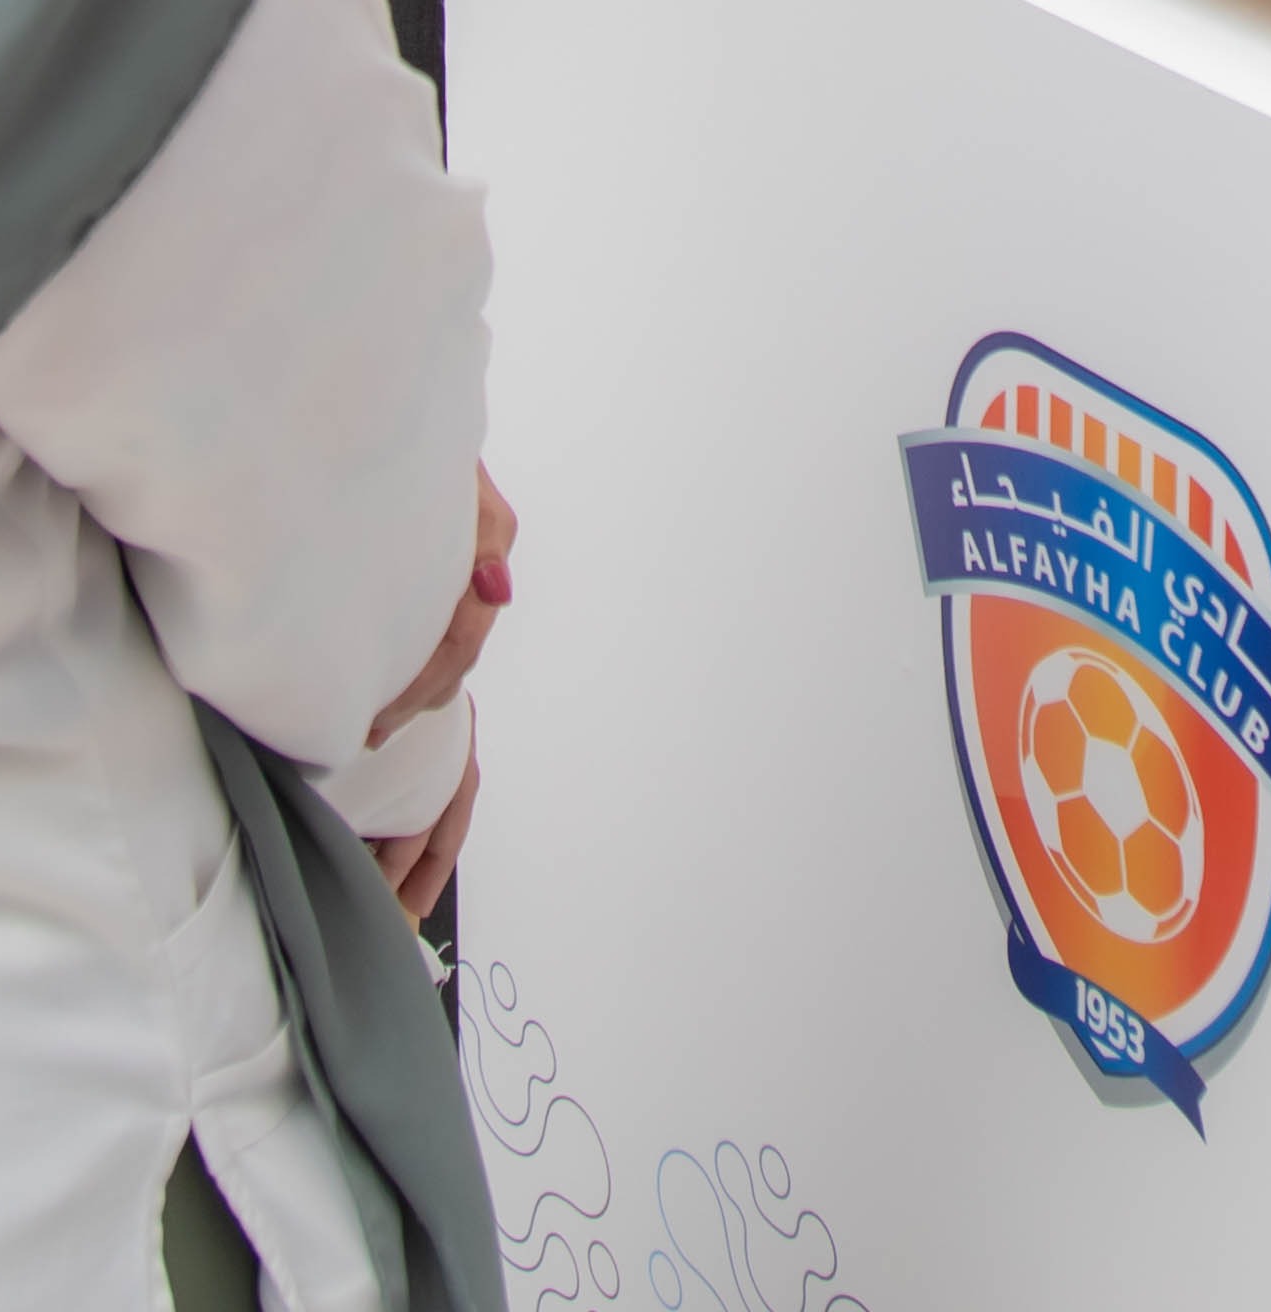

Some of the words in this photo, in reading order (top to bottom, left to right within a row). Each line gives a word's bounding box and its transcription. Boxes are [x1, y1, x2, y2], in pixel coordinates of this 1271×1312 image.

[951, 451, 1156, 573] الفيحاء
[962, 529, 1141, 635] ALFAYHA
[1159, 621, 1270, 755] CLUB
[1075, 978, 1145, 1064] 1953
